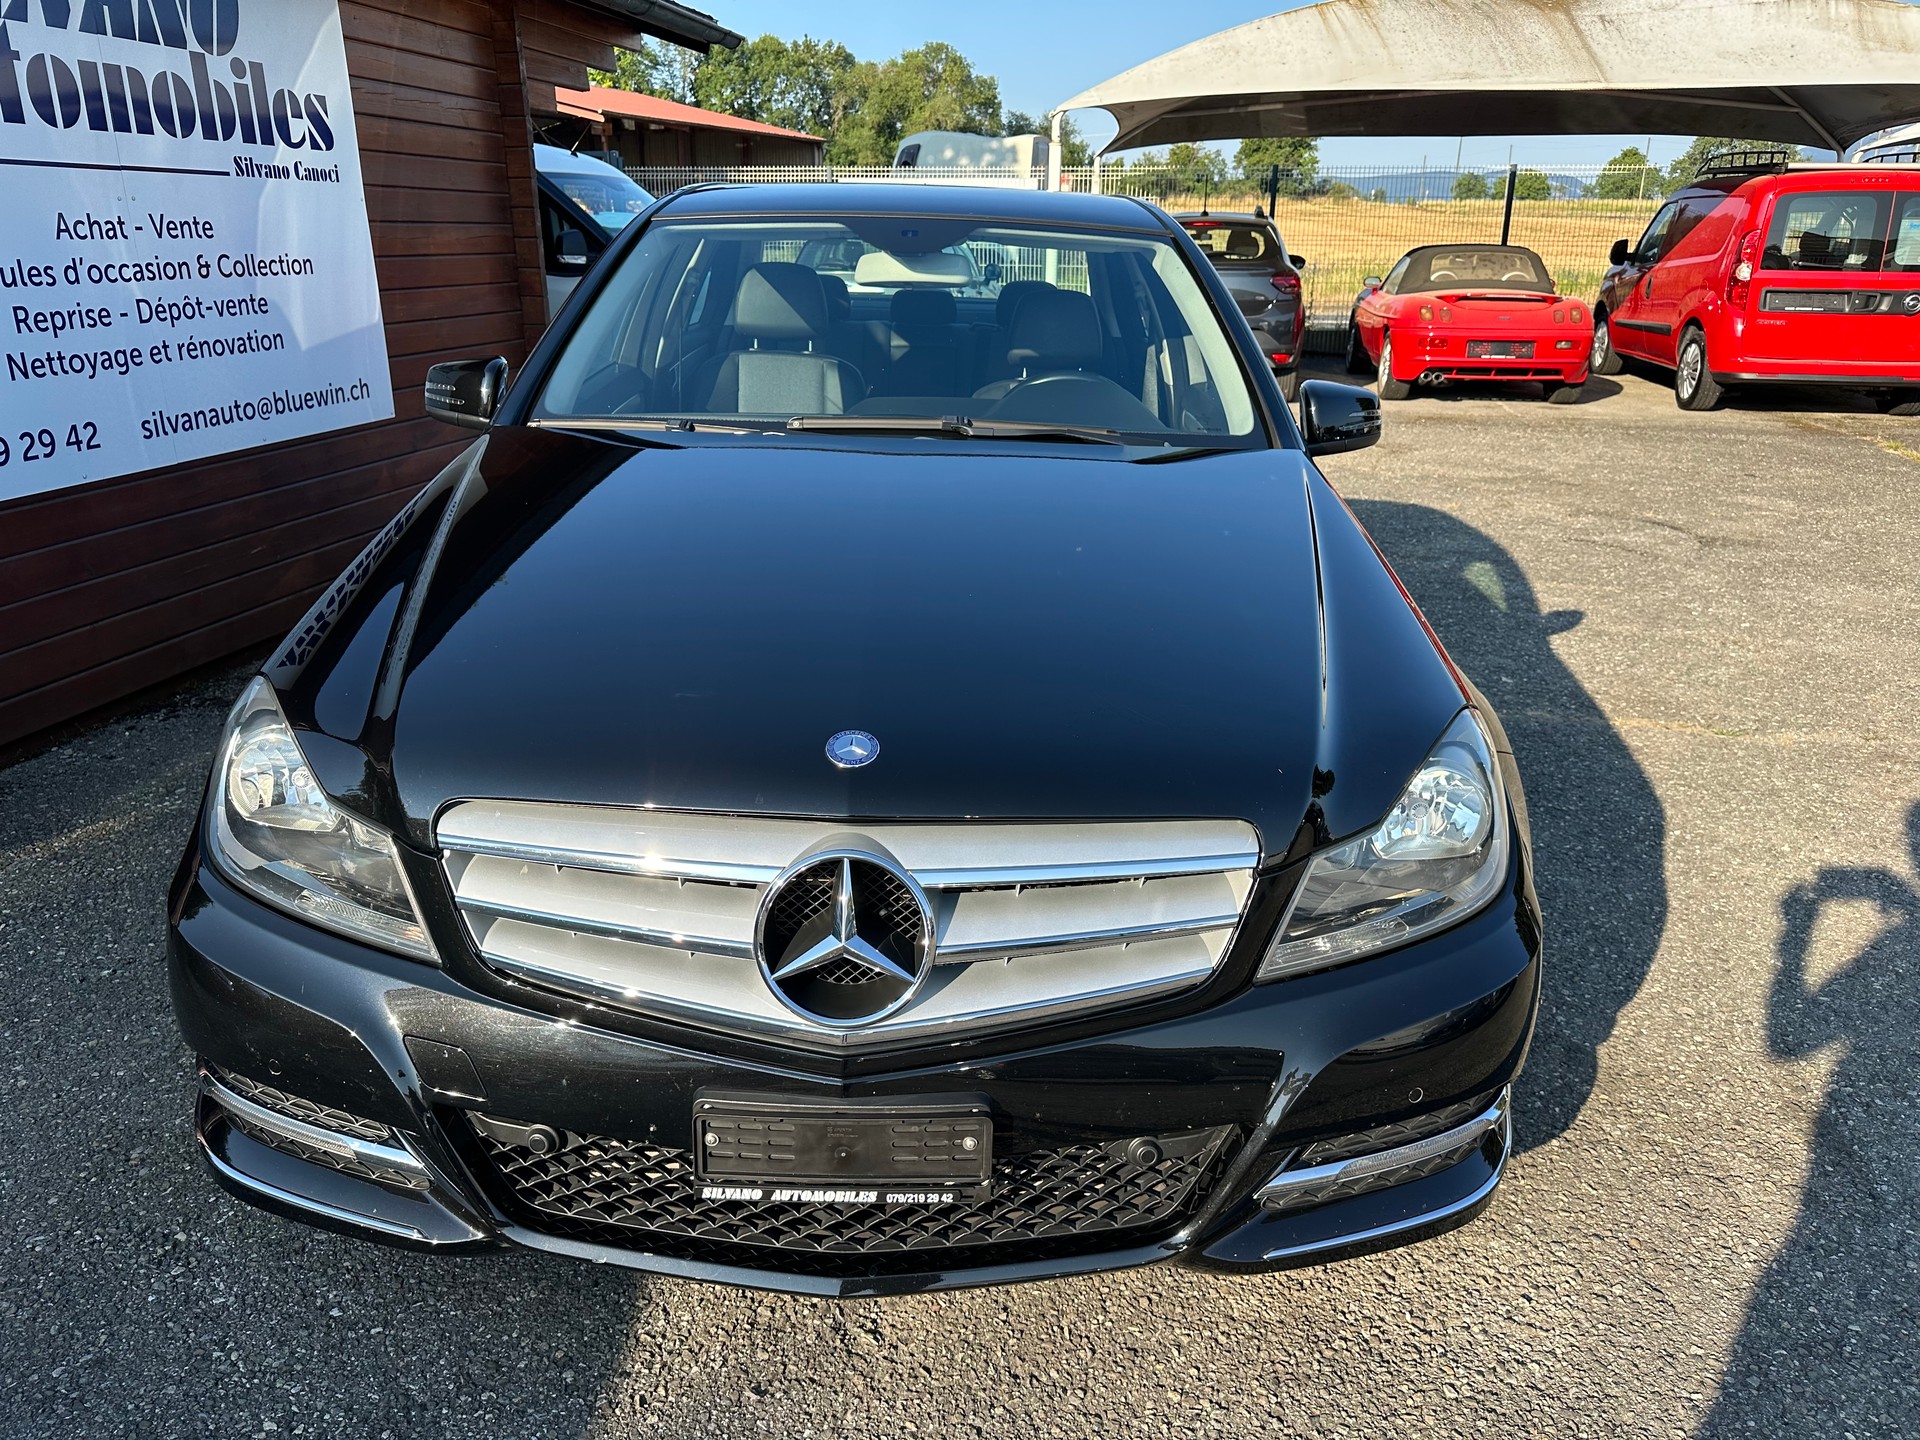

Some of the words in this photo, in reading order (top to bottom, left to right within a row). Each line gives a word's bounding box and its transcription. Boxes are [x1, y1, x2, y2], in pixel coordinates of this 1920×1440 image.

[233, 156, 290, 180] Silvano
[294, 161, 340, 183] Canoci
[56, 212, 128, 240] Achat
[148, 213, 215, 240] Vente
[0, 258, 57, 288] ules
[64, 255, 192, 286] d'occasion
[197, 254, 211, 279] &
[217, 253, 314, 279] Collection
[12, 301, 113, 339] Reprise
[135, 293, 269, 328] Dépôt-vente
[6, 347, 144, 382] Nettoyage
[149, 341, 173, 365] et
[176, 329, 285, 361] rénovation
[140, 378, 371, 441] silvanauto@bluewin.ch
[18, 428, 56, 463] 29
[65, 421, 102, 453] 42
[701, 1187, 763, 1200] SILVANO
[770, 1189, 878, 1203] AUTOMOBILES
[886, 1193, 925, 1203] 079/219
[926, 1193, 939, 1203] 29
[940, 1193, 953, 1203] 42
